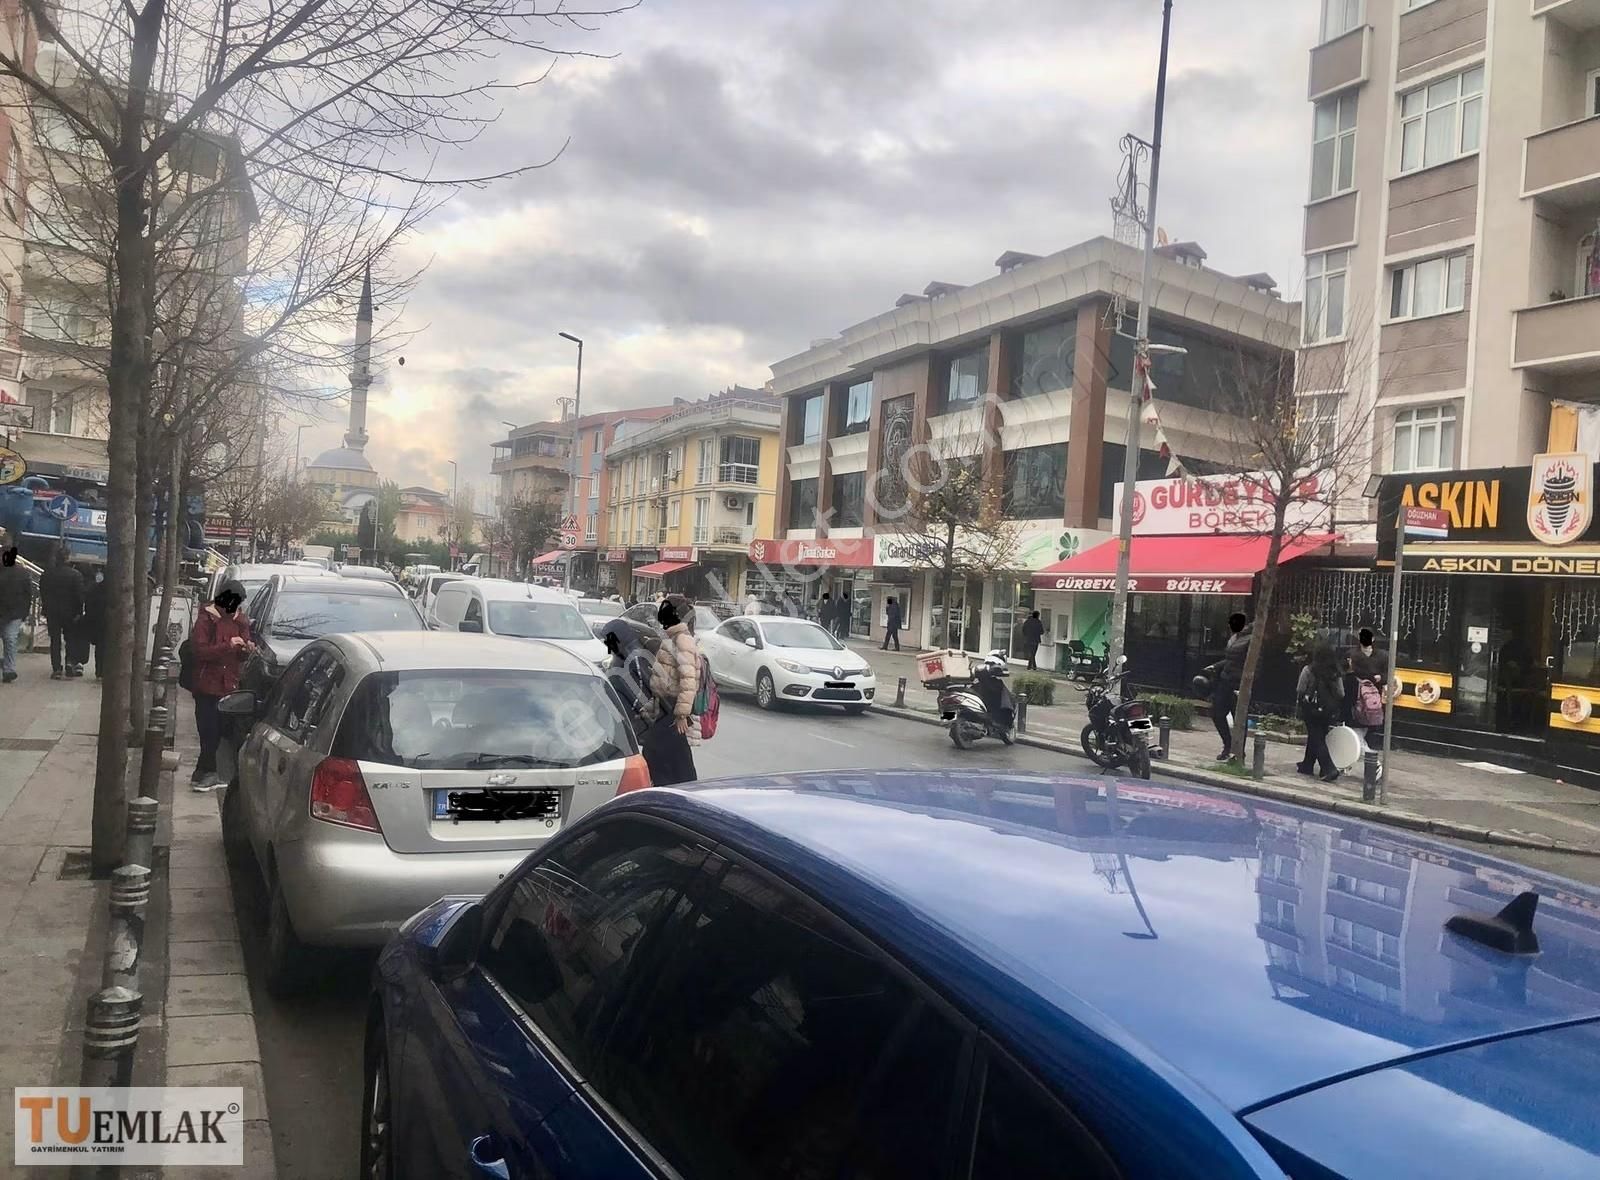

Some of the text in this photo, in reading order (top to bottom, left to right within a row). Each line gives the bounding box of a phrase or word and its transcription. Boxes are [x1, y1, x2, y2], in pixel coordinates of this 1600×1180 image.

[1151, 477, 1319, 509] GÜRBEYLR
[1189, 508, 1271, 528] BÖREK
[566, 536, 576, 545] 30
[1423, 558, 1501, 573] AŞKIN
[1056, 577, 1227, 592] GÜRBEYLR BÖREK
